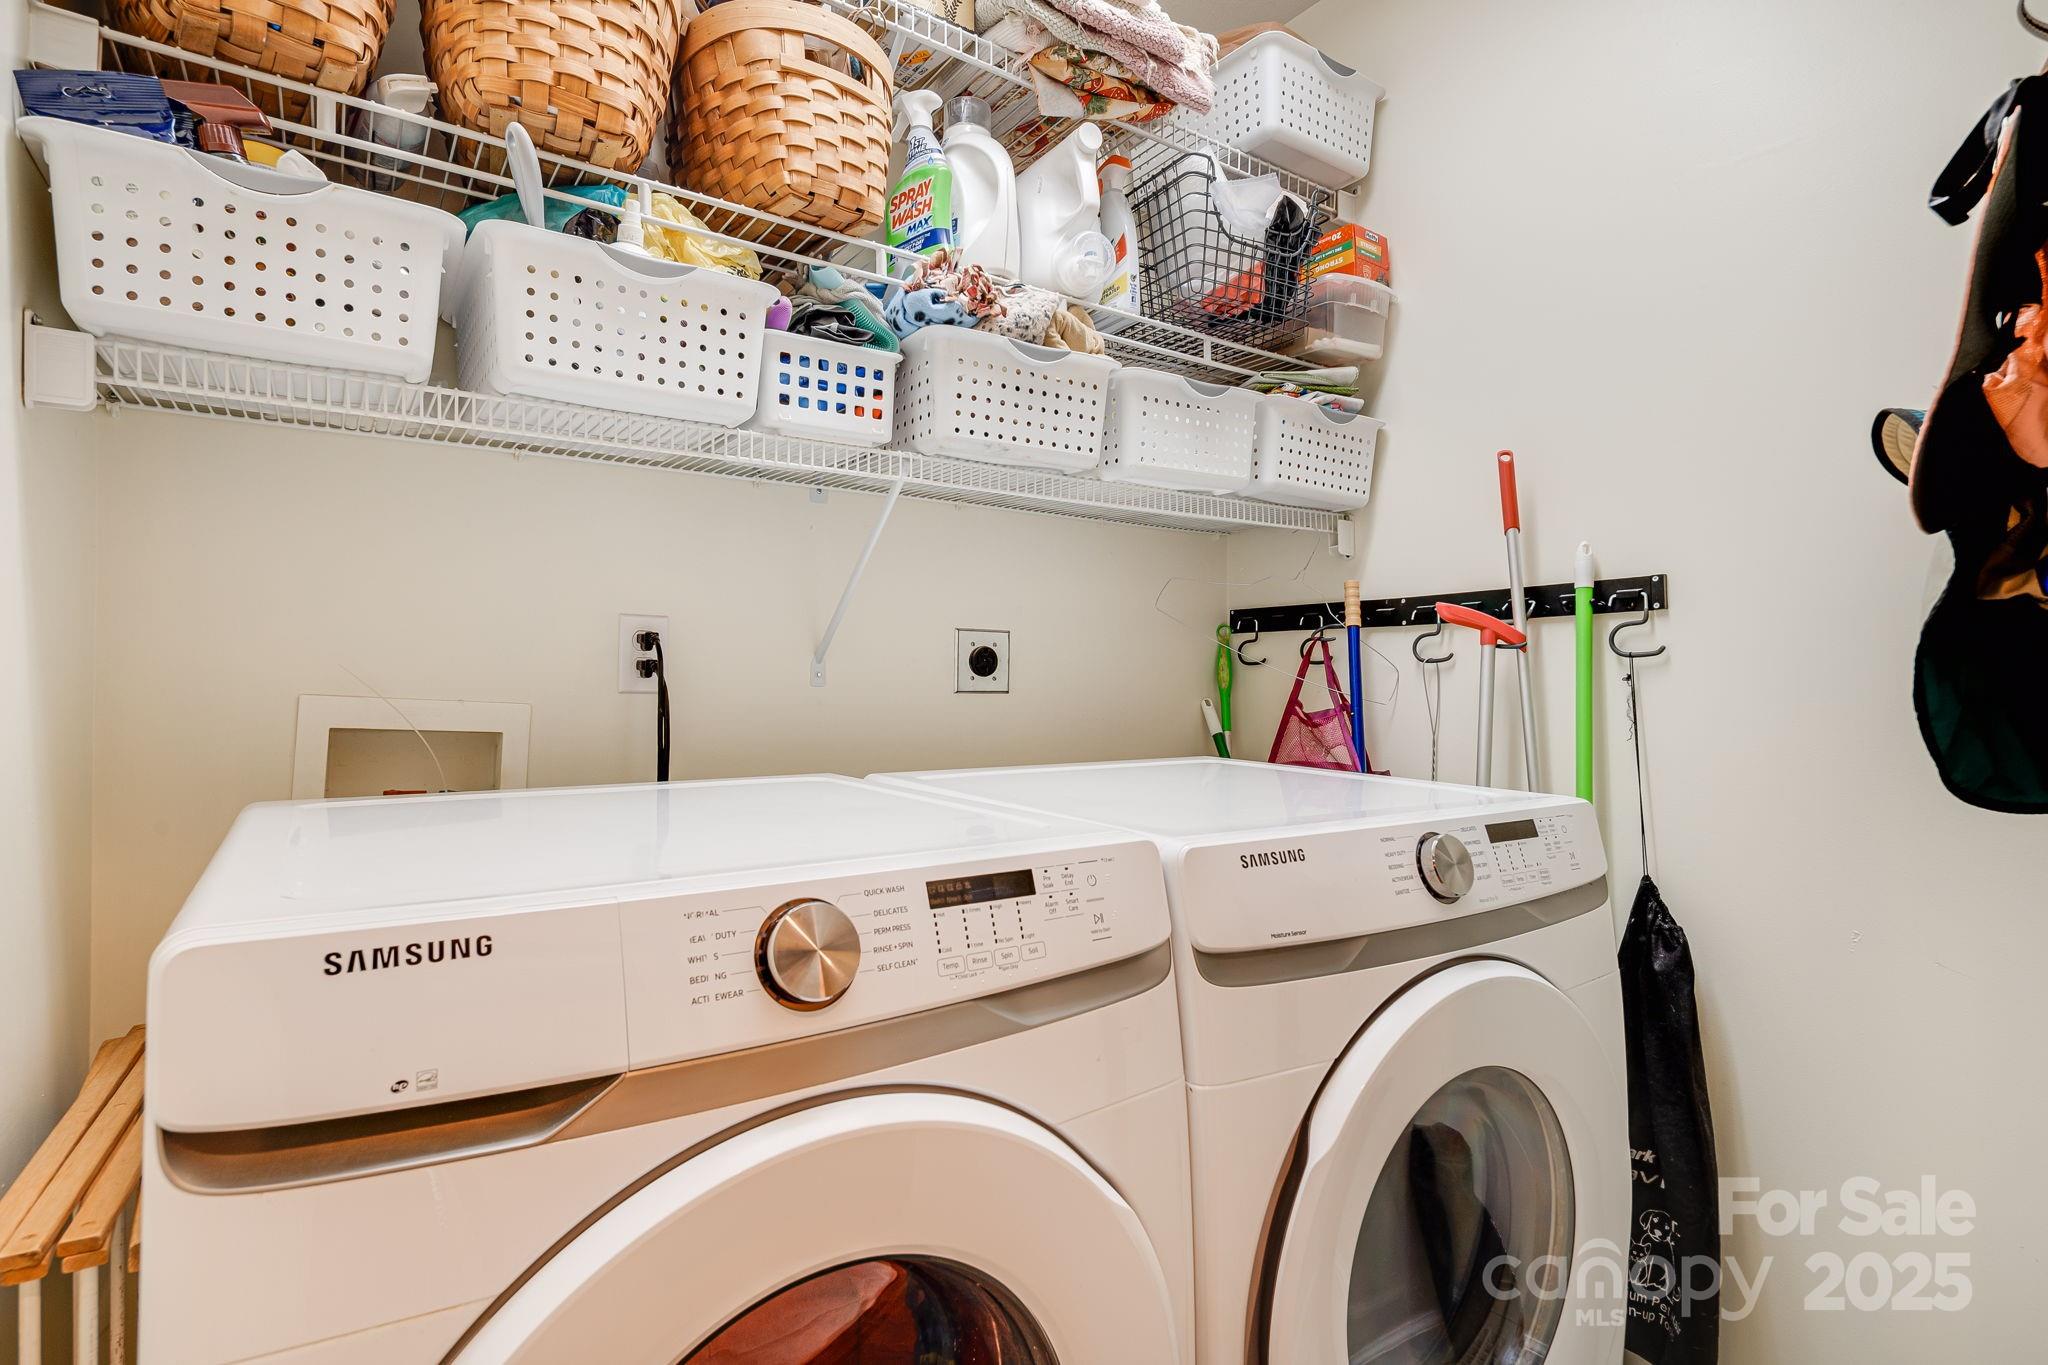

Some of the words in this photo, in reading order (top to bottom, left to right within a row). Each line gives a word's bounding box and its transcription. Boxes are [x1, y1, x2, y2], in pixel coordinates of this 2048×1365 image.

[889, 177, 932, 213] SPRAY
[891, 196, 933, 230] WASH
[906, 215, 933, 235] MAX
[1240, 848, 1306, 869] SAMSUNG
[863, 888, 885, 897] QUICK
[886, 885, 905, 894] WASH
[873, 906, 909, 917] DELICATES
[715, 930, 737, 940] DUTY
[873, 926, 892, 936] PERM
[892, 923, 912, 932] PRESS
[873, 944, 893, 954] RINSE
[898, 941, 914, 950] SPIN
[323, 935, 493, 976] SAMSUNG
[971, 957, 988, 965] Rinse
[1001, 951, 1014, 960] Spin
[877, 961, 894, 973] SELF
[691, 989, 745, 1005] ACTIEWEAR
